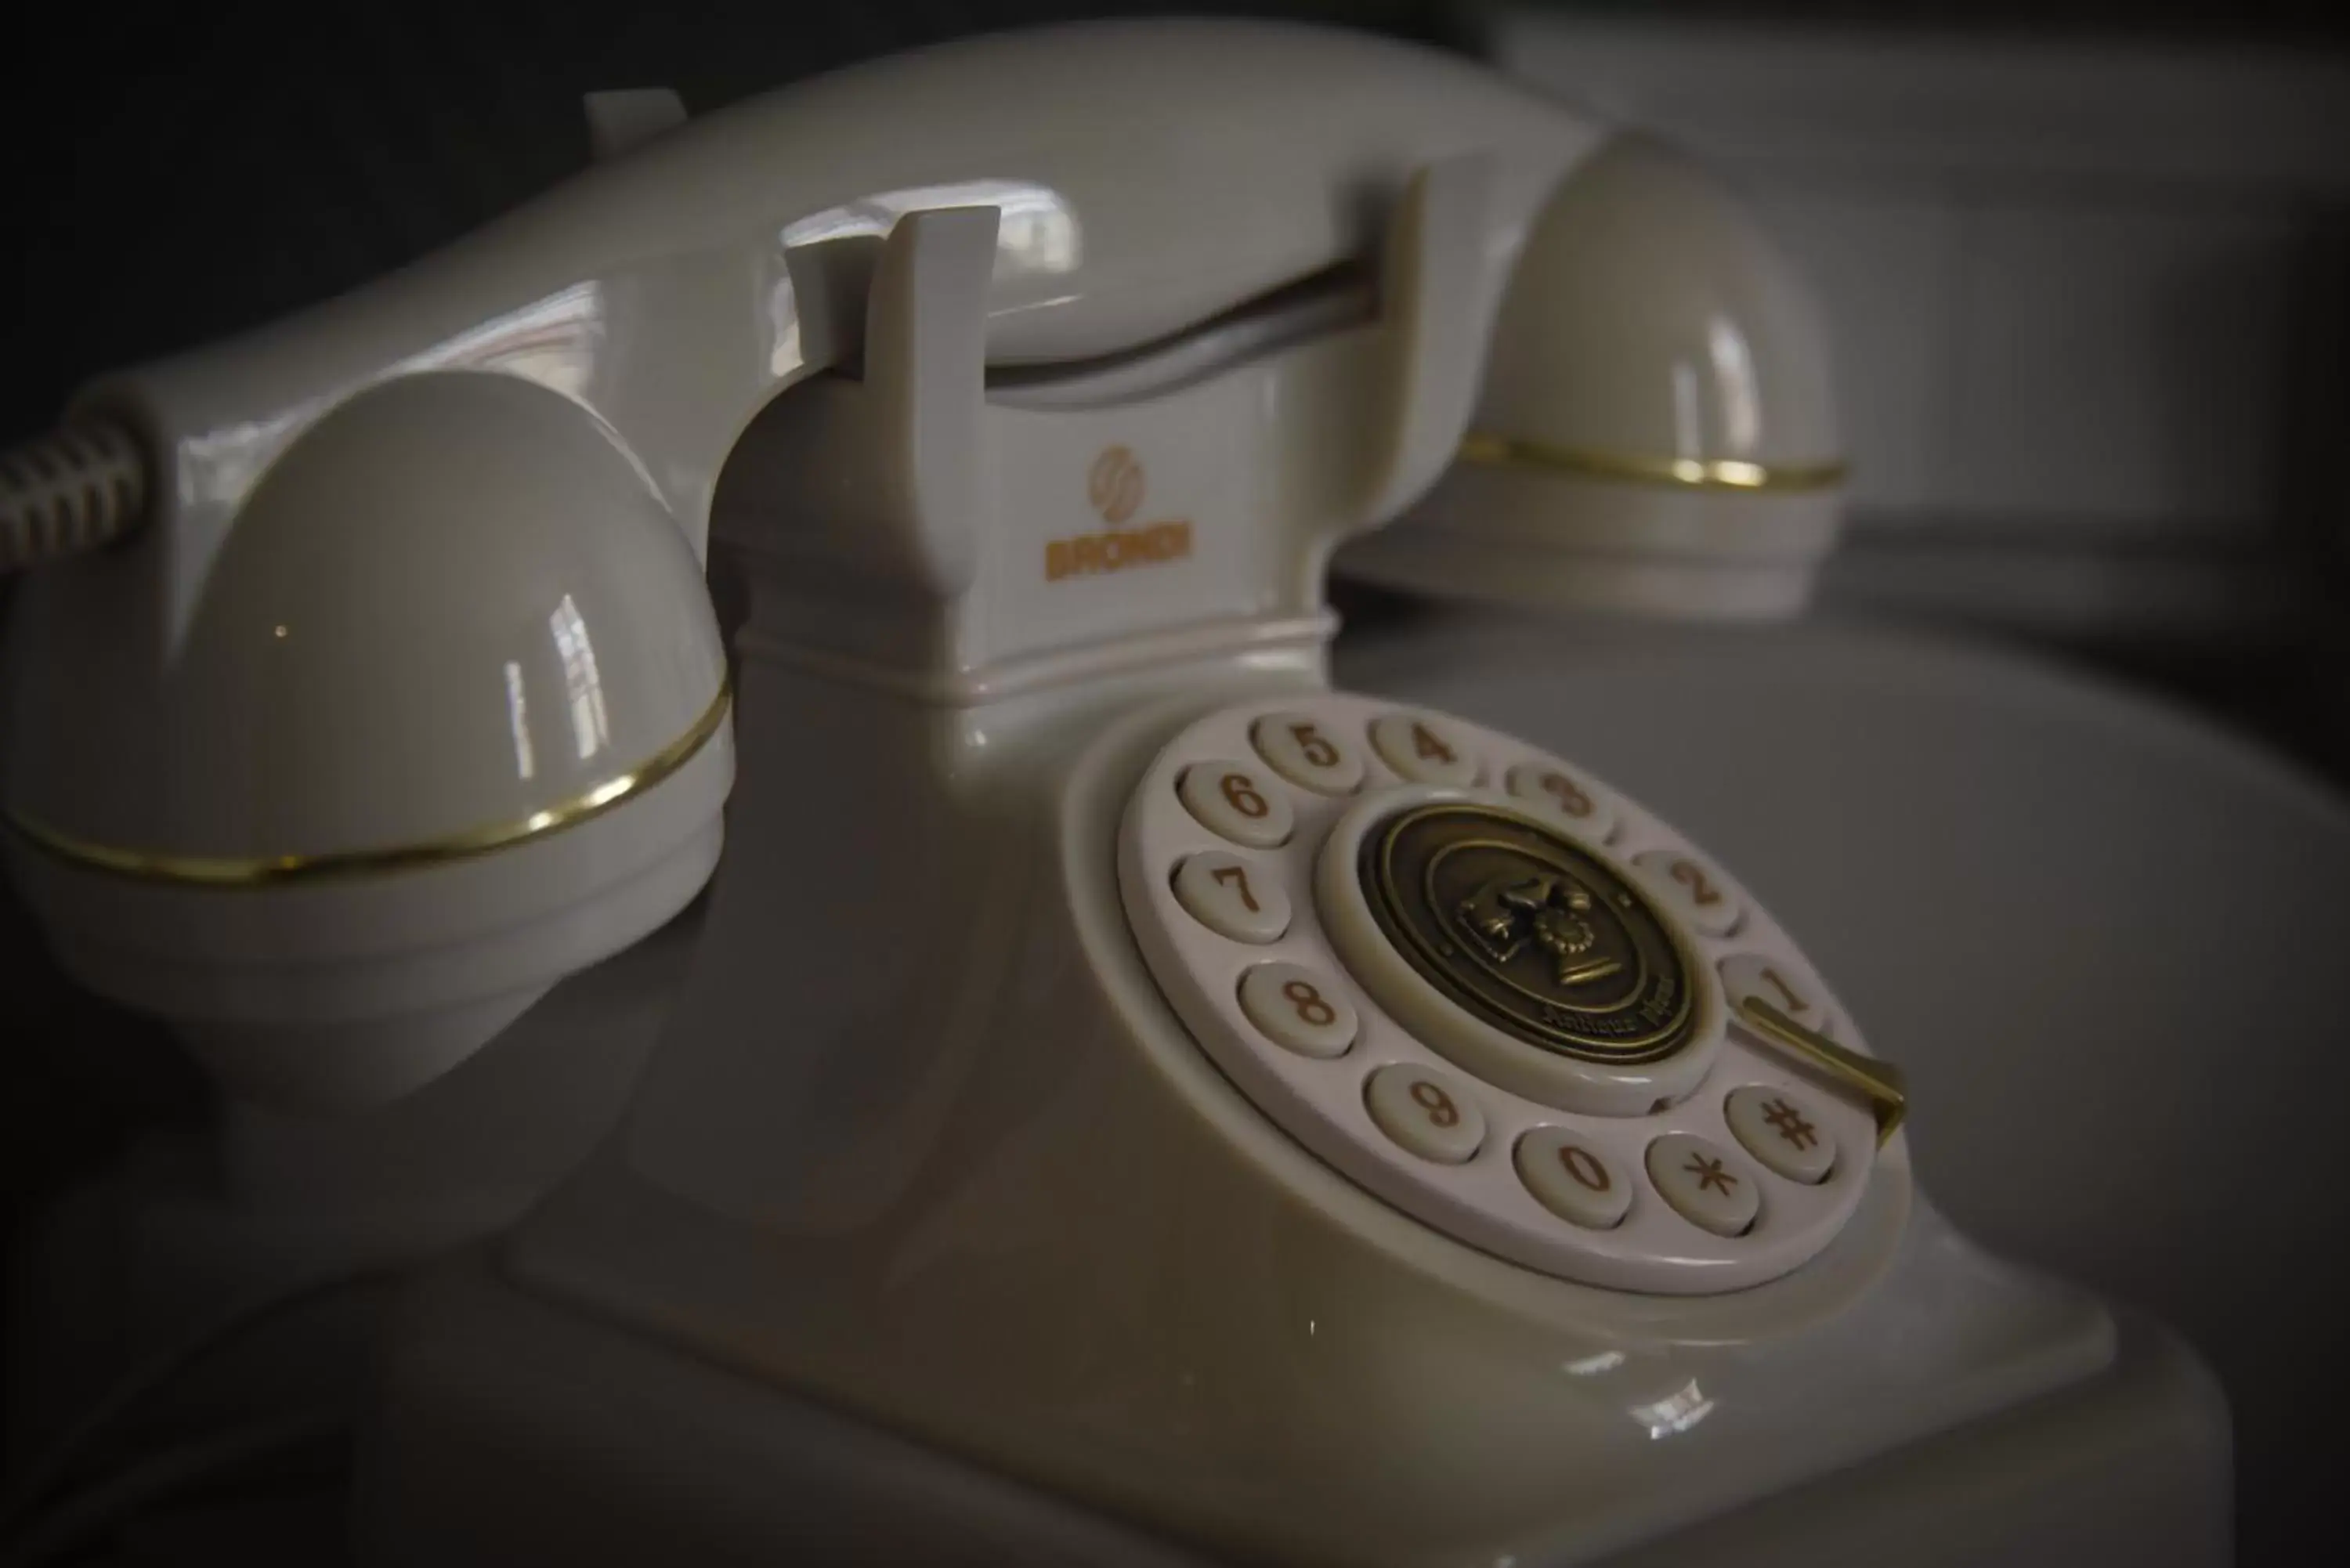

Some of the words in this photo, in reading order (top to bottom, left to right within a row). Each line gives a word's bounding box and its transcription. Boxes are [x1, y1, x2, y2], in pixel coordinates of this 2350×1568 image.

[1290, 725, 1340, 767] 5
[1412, 724, 1457, 764] 4
[1222, 774, 1268, 818] 6
[1540, 771, 1592, 817] 3
[1212, 866, 1260, 912] 7
[1671, 862, 1721, 905] 2
[1283, 981, 1335, 1025] 8
[1761, 967, 1809, 1011] 1
[1409, 1081, 1460, 1128] 9
[1761, 1098, 1818, 1151] #
[1559, 1146, 1610, 1191] 0
